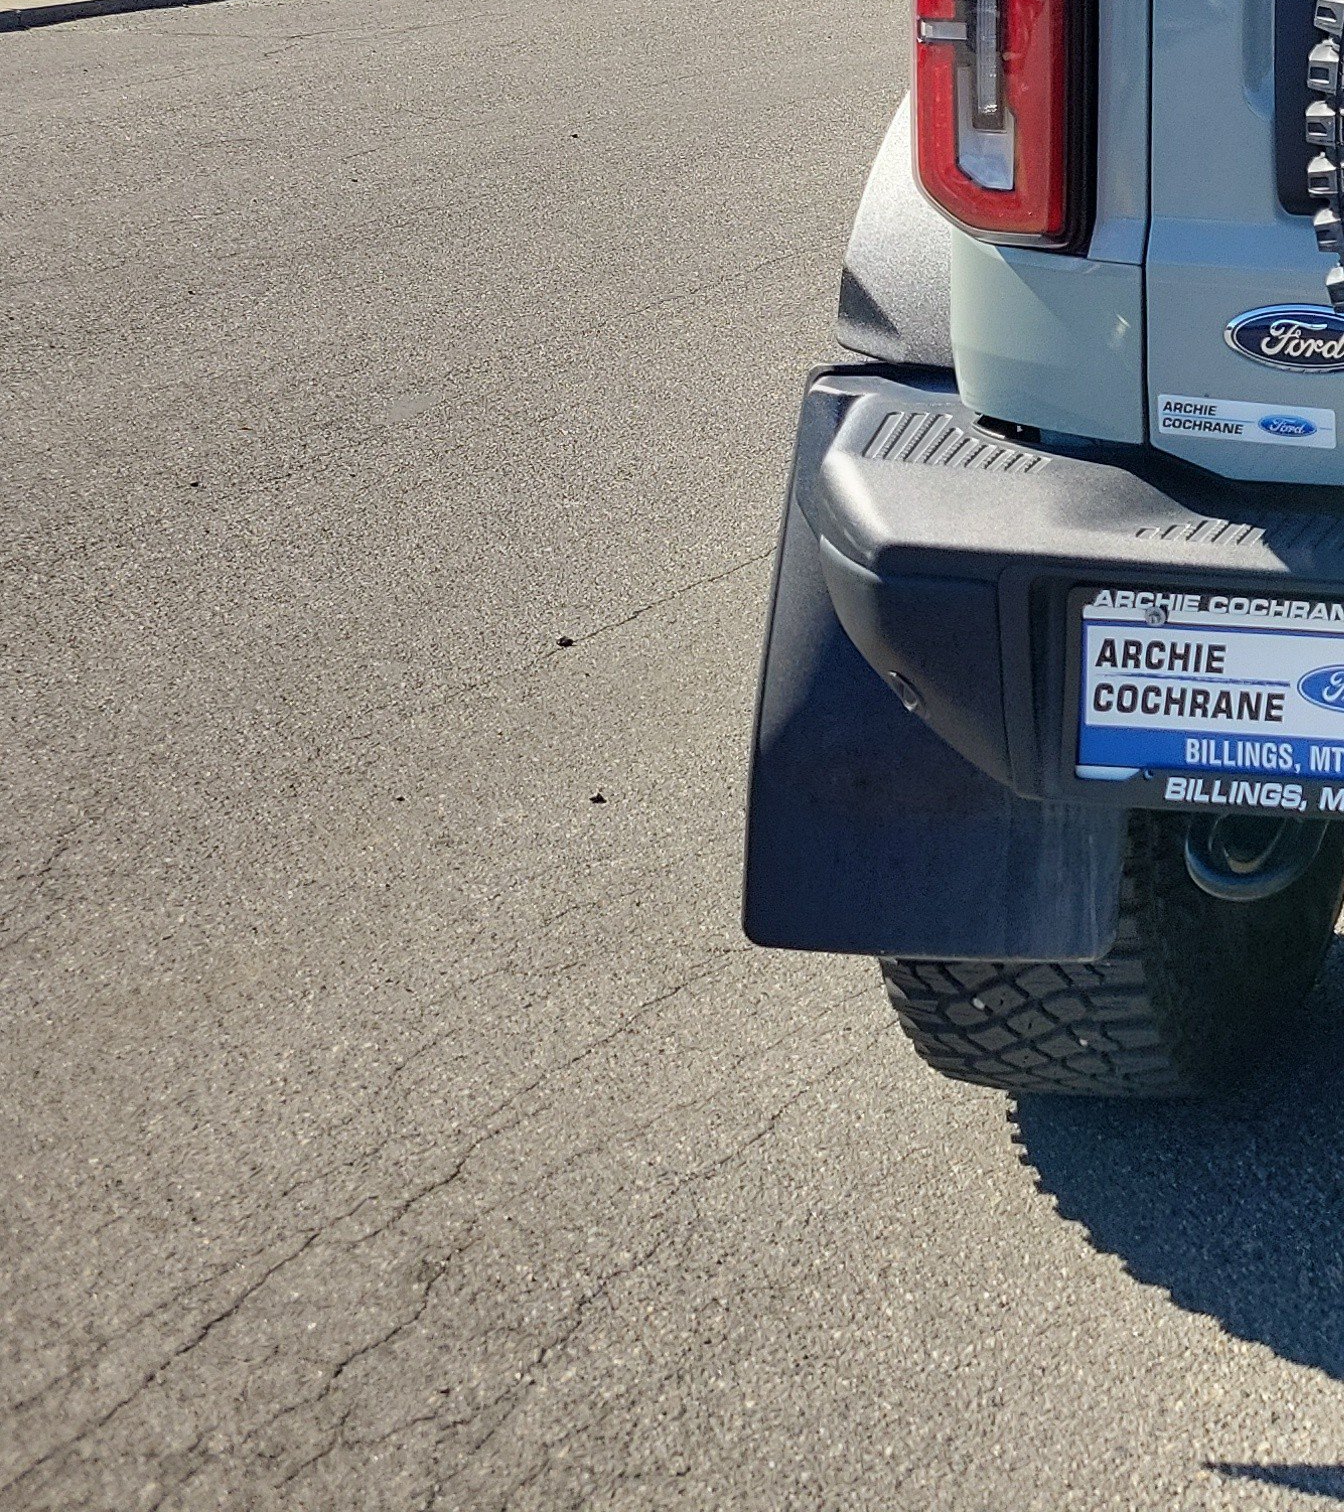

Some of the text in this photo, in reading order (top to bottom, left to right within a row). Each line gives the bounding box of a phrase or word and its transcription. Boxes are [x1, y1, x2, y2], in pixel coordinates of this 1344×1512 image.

[1163, 400, 1217, 416] ARCHIE
[1162, 417, 1305, 435] COCHRANE Ford
[1094, 589, 1201, 610] ARCHIE
[1095, 637, 1227, 675] ARCHIE
[1093, 681, 1286, 723] COCHRANE
[1185, 738, 1301, 775] BILLINGS,
[1164, 777, 1309, 812] BILLINGS,
